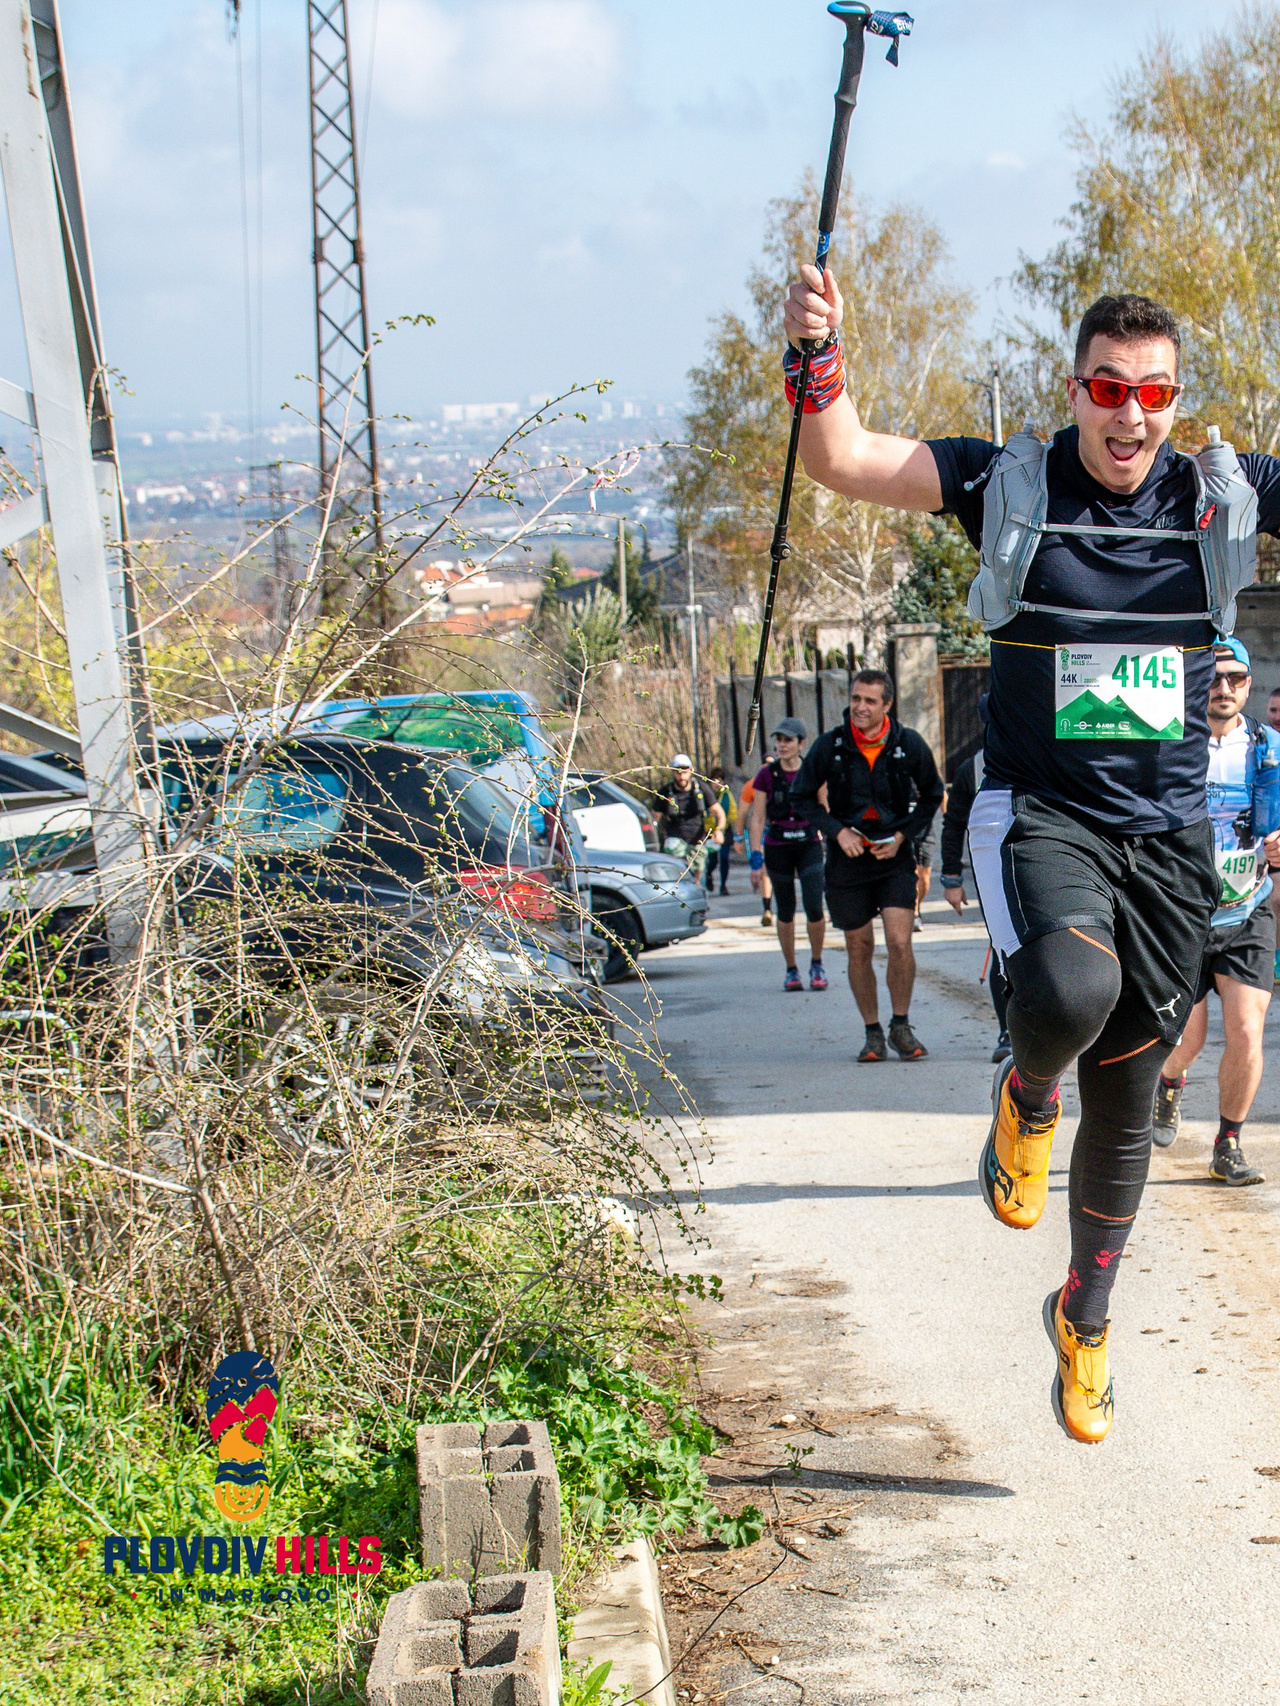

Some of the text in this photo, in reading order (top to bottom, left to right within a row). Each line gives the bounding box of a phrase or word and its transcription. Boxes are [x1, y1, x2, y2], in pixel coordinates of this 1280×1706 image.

[1155, 514, 1176, 529] NIKE
[1060, 673, 1078, 684] 44K
[1112, 654, 1177, 689] 4145
[1222, 855, 1255, 875] 4197
